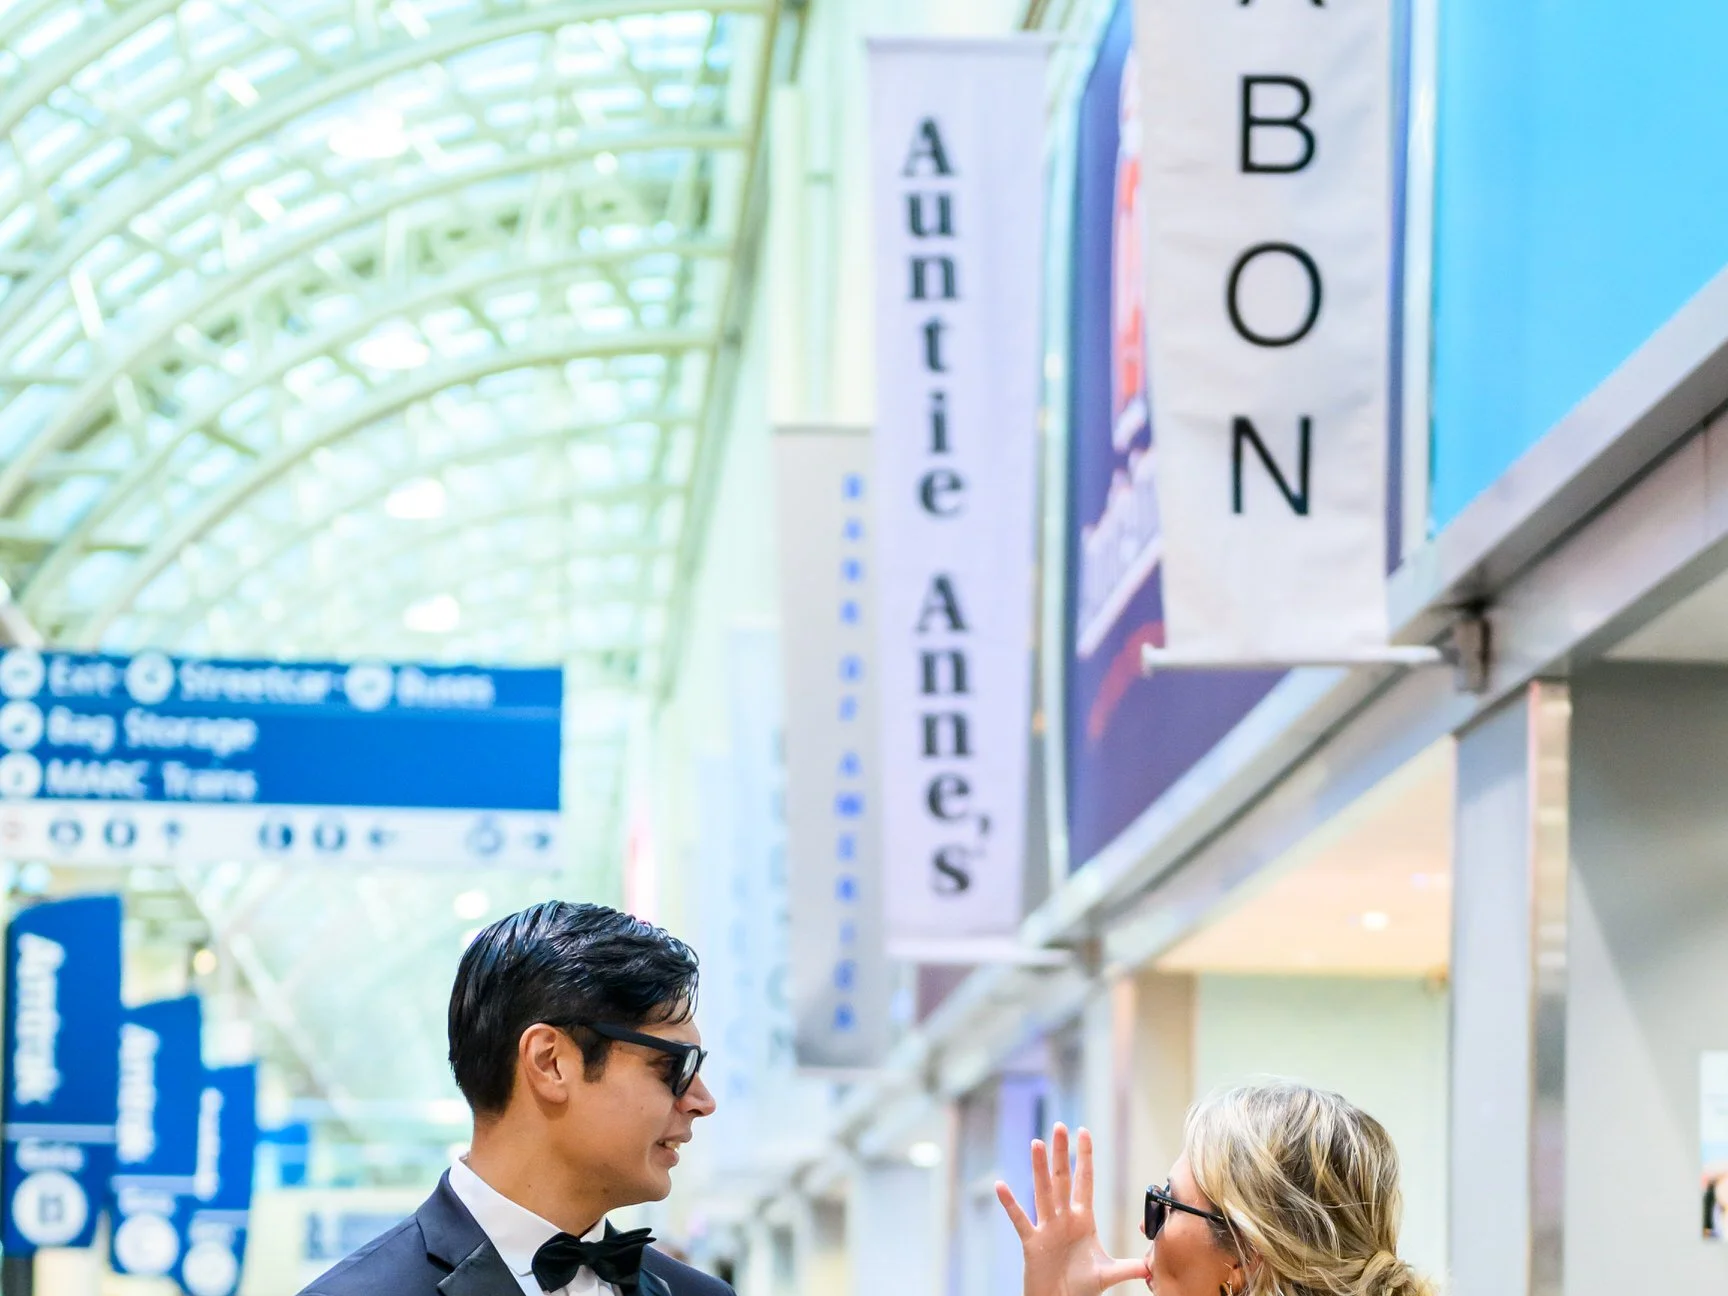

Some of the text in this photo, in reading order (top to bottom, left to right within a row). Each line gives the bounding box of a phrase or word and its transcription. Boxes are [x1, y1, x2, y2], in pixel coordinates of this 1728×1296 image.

[903, 115, 992, 896] Auntie Anne's
[1226, 0, 1326, 517] BON
